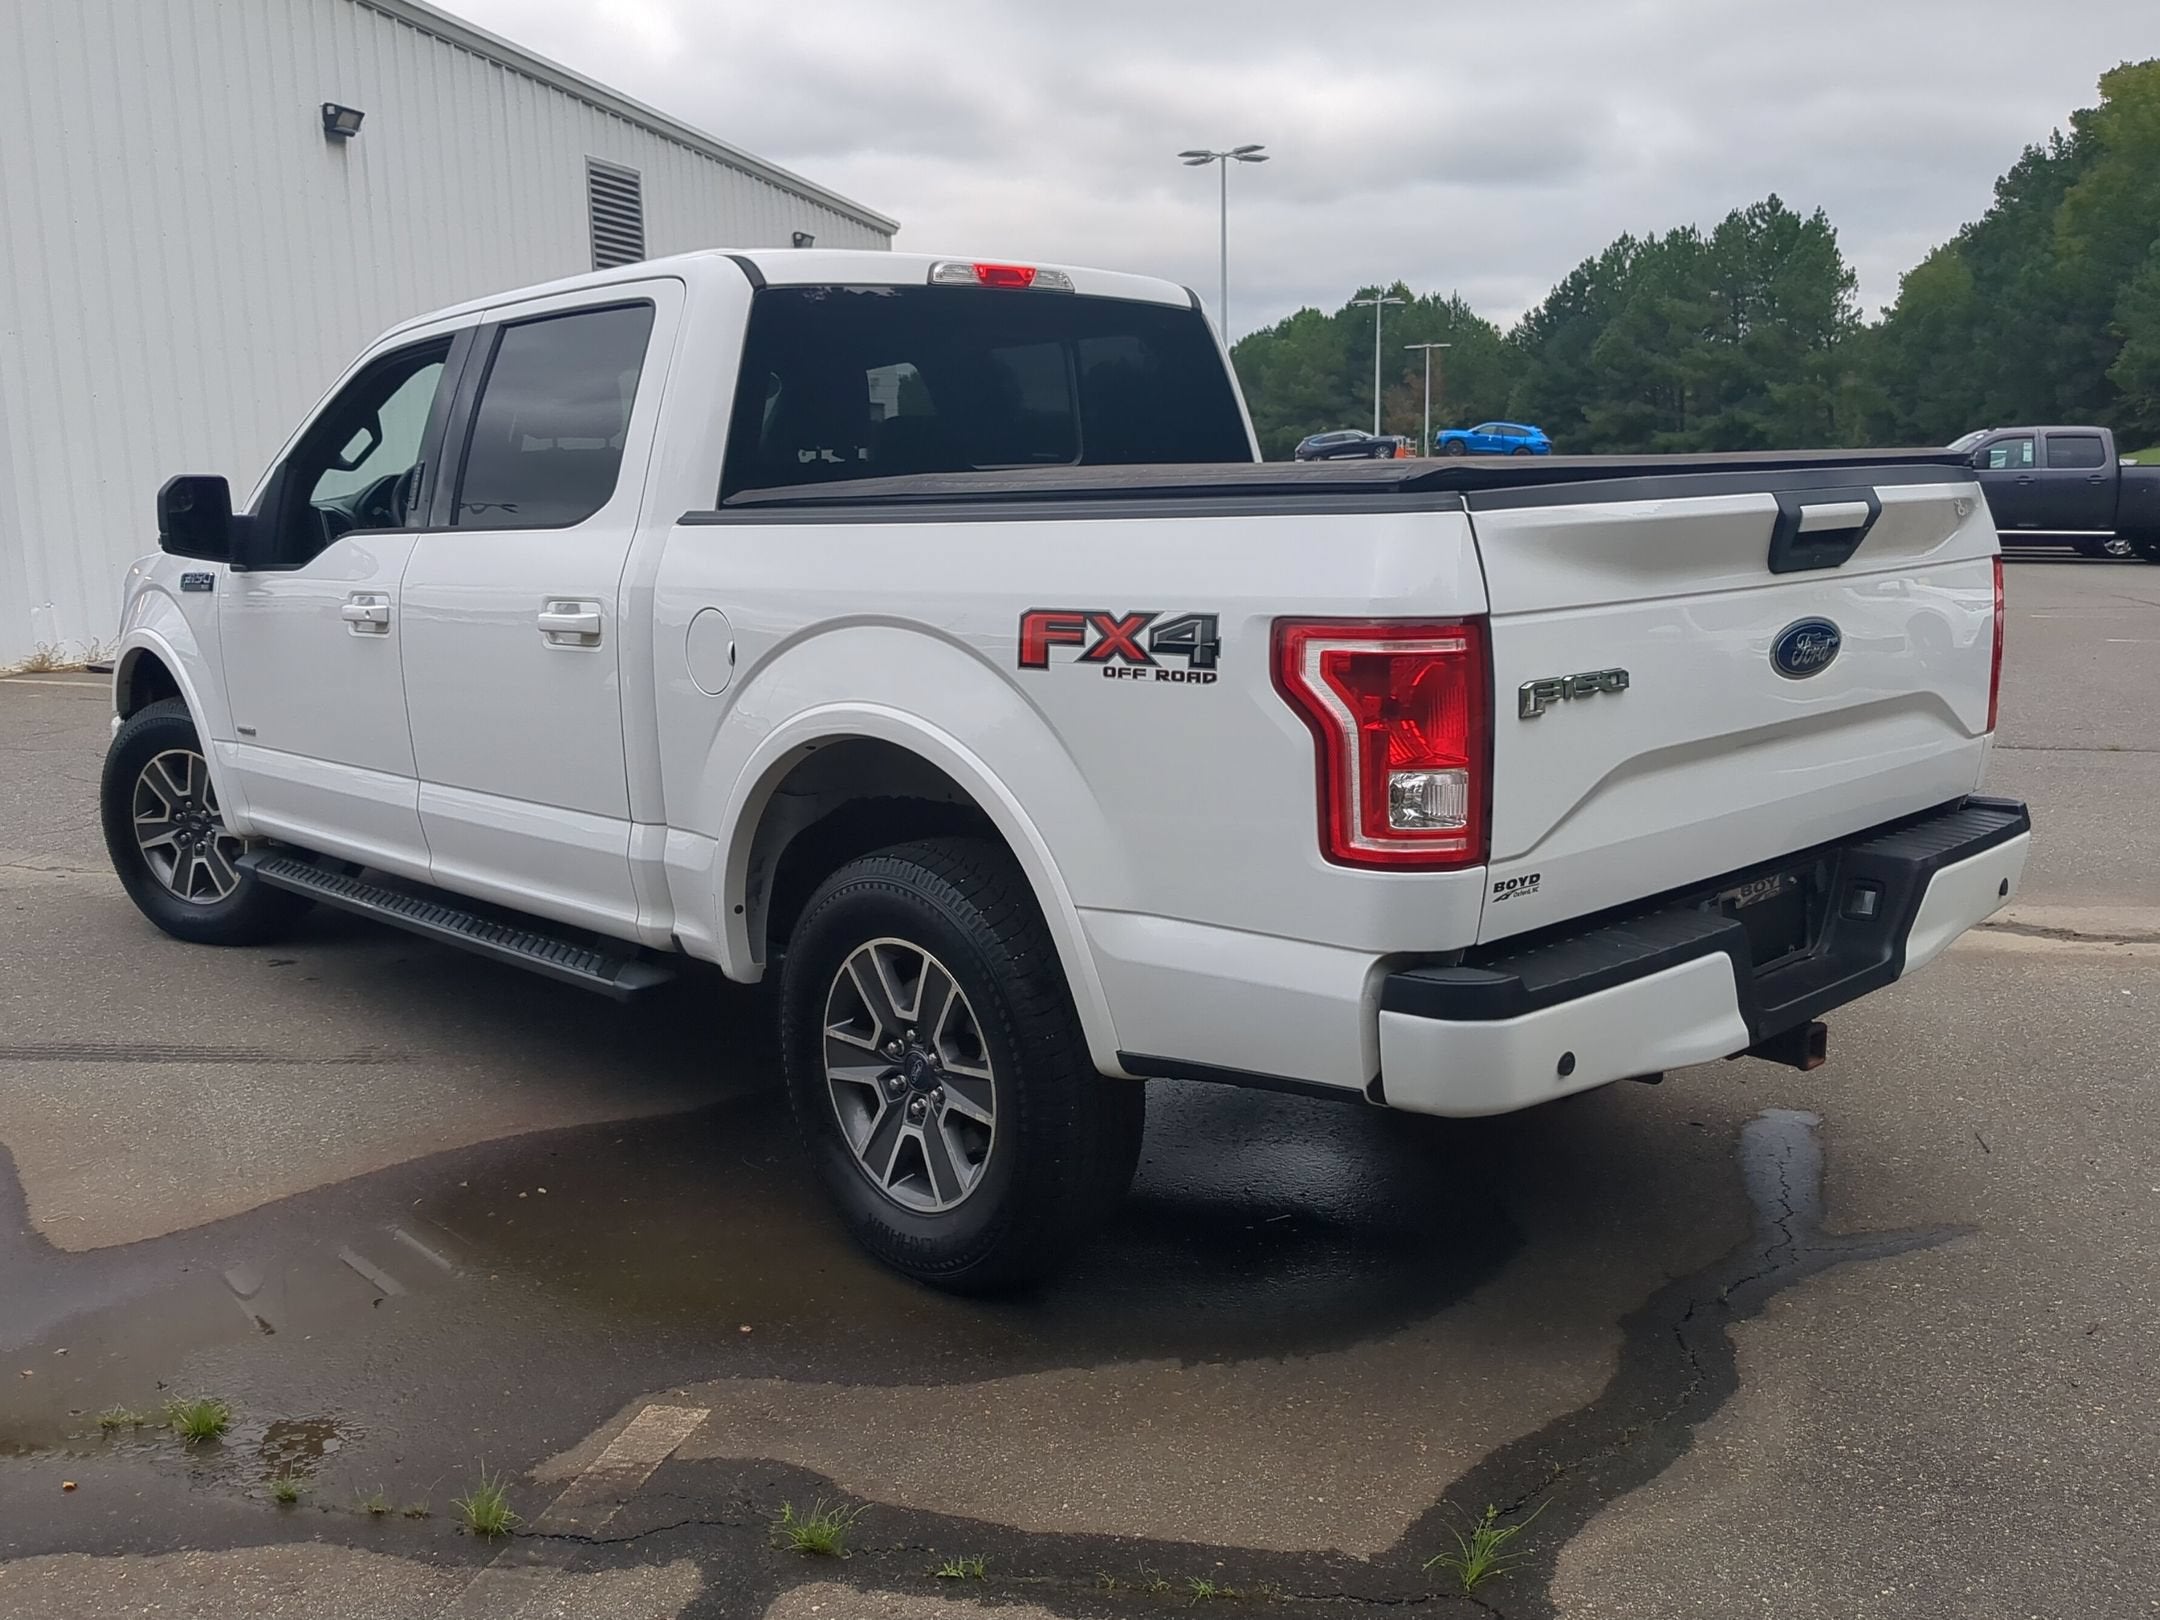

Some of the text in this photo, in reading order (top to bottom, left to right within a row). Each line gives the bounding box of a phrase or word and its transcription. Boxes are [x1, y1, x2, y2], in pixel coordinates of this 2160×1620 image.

[1018, 608, 1220, 671] FX4
[1792, 632, 1838, 666] Ford
[1103, 666, 1217, 684] OFF ROAD
[1493, 873, 1541, 893] BOYD
